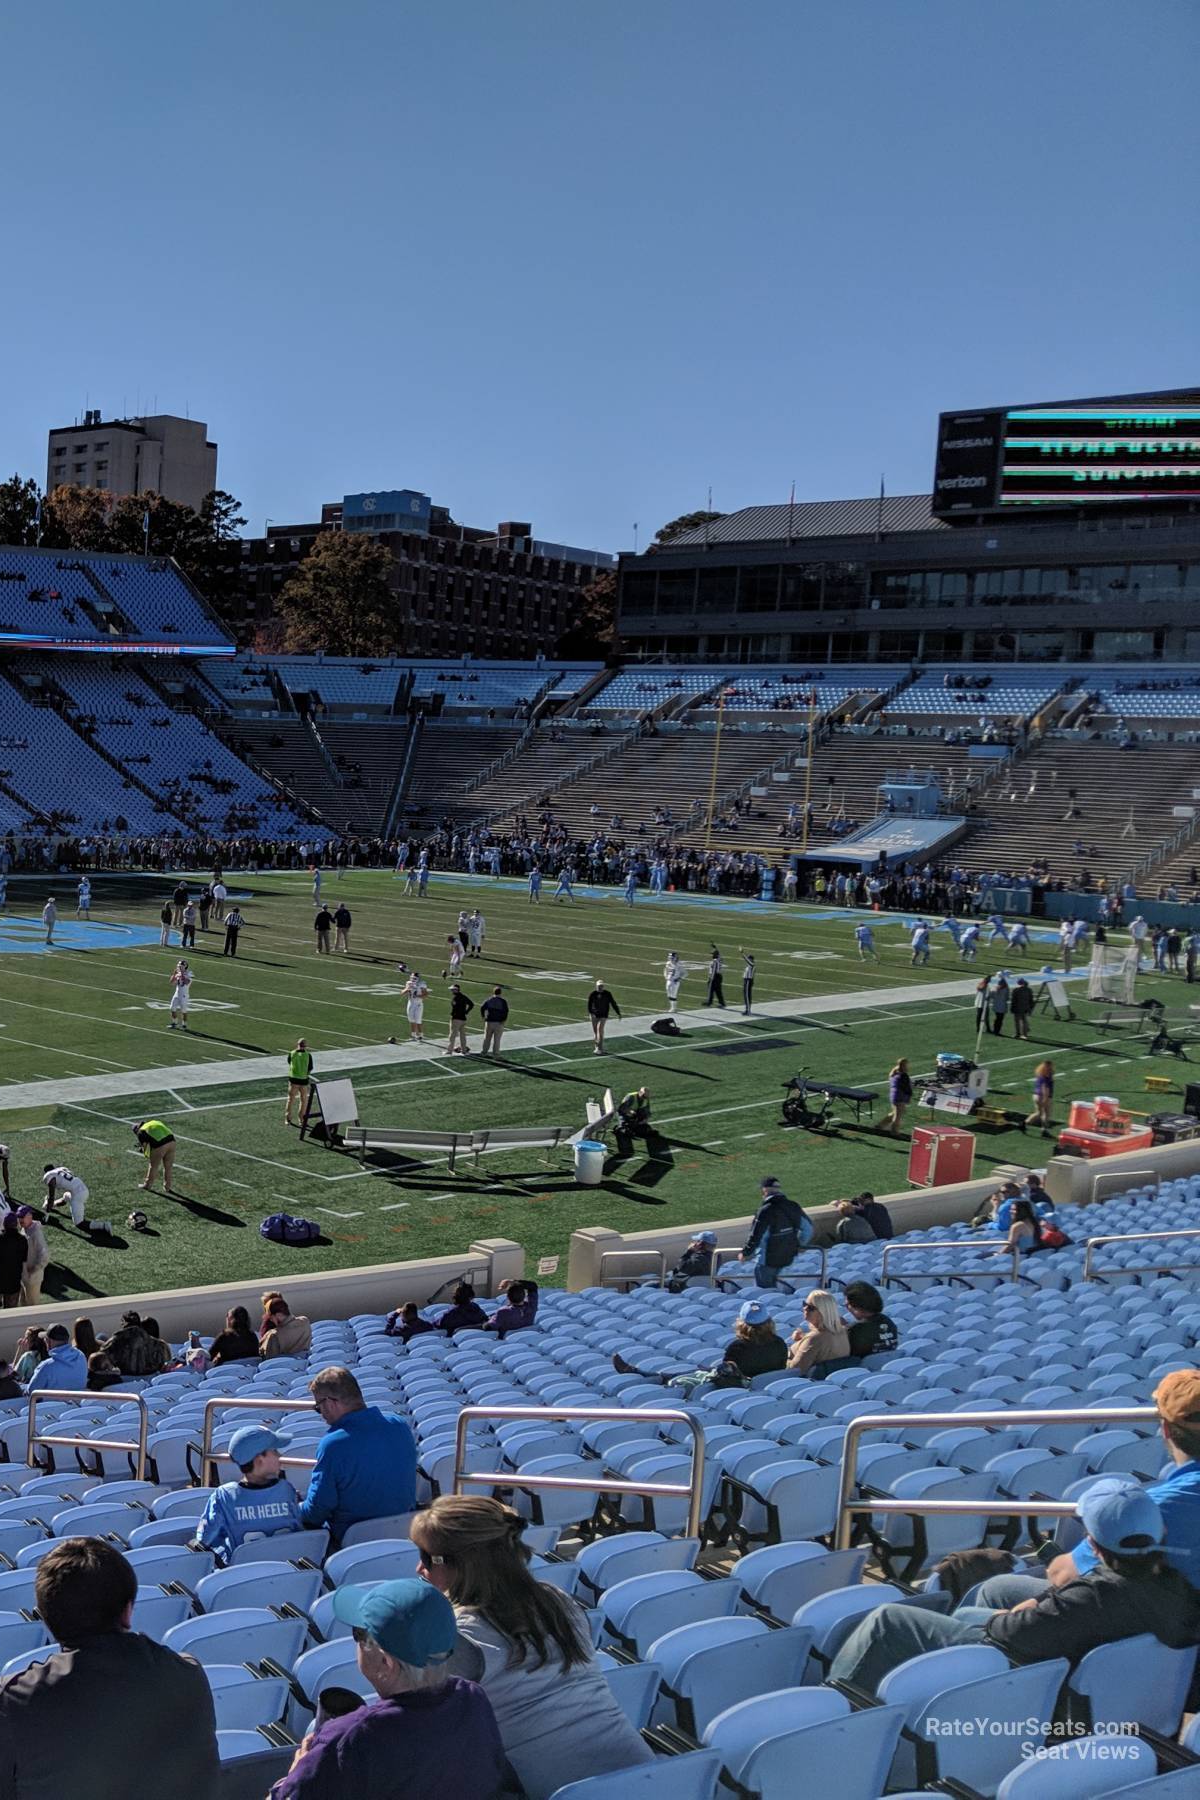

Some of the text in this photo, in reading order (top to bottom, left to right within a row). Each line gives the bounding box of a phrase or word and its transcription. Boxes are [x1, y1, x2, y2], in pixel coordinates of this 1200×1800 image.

[943, 437, 993, 449] NISSAN
[937, 474, 987, 489] verizon
[234, 1502, 289, 1520] TAR HEELS
